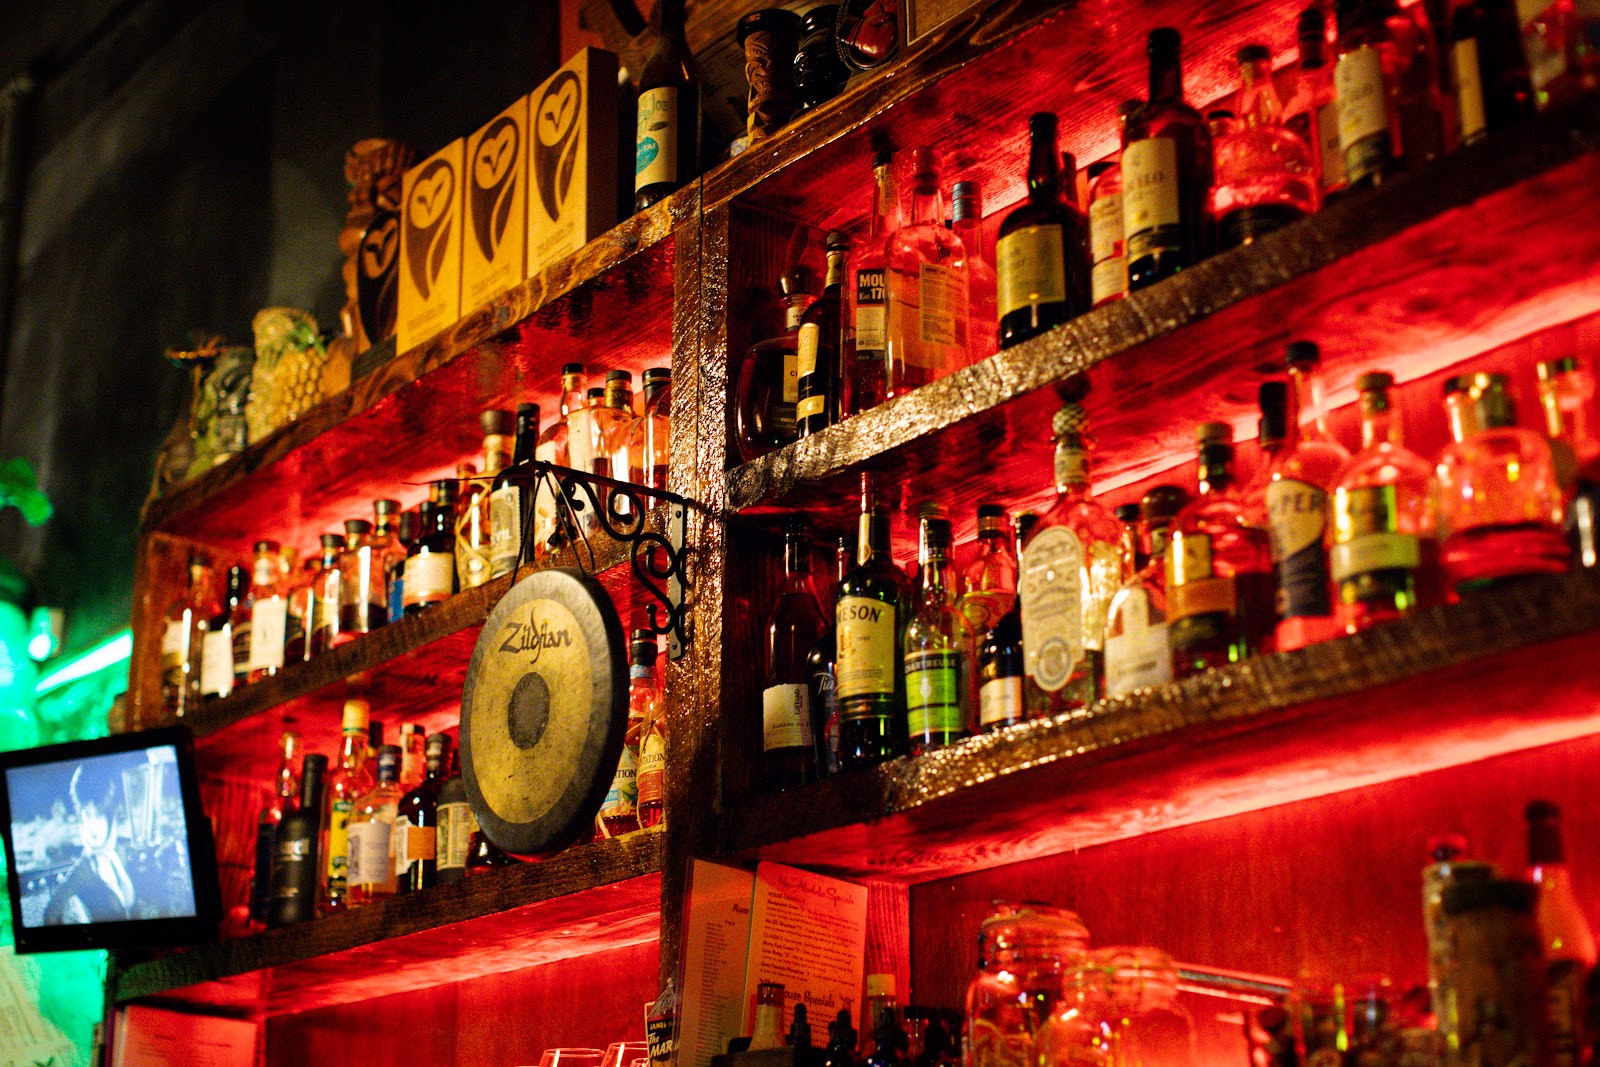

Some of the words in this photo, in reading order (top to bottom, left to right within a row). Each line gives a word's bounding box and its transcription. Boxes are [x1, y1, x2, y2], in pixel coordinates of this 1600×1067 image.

[498, 606, 573, 665] Zildjian
[732, 903, 749, 914] Rum
[784, 990, 802, 1001] ouse
[803, 990, 836, 1008] Specials
[650, 1021, 667, 1031] JAMES
[648, 1032, 660, 1045] The
